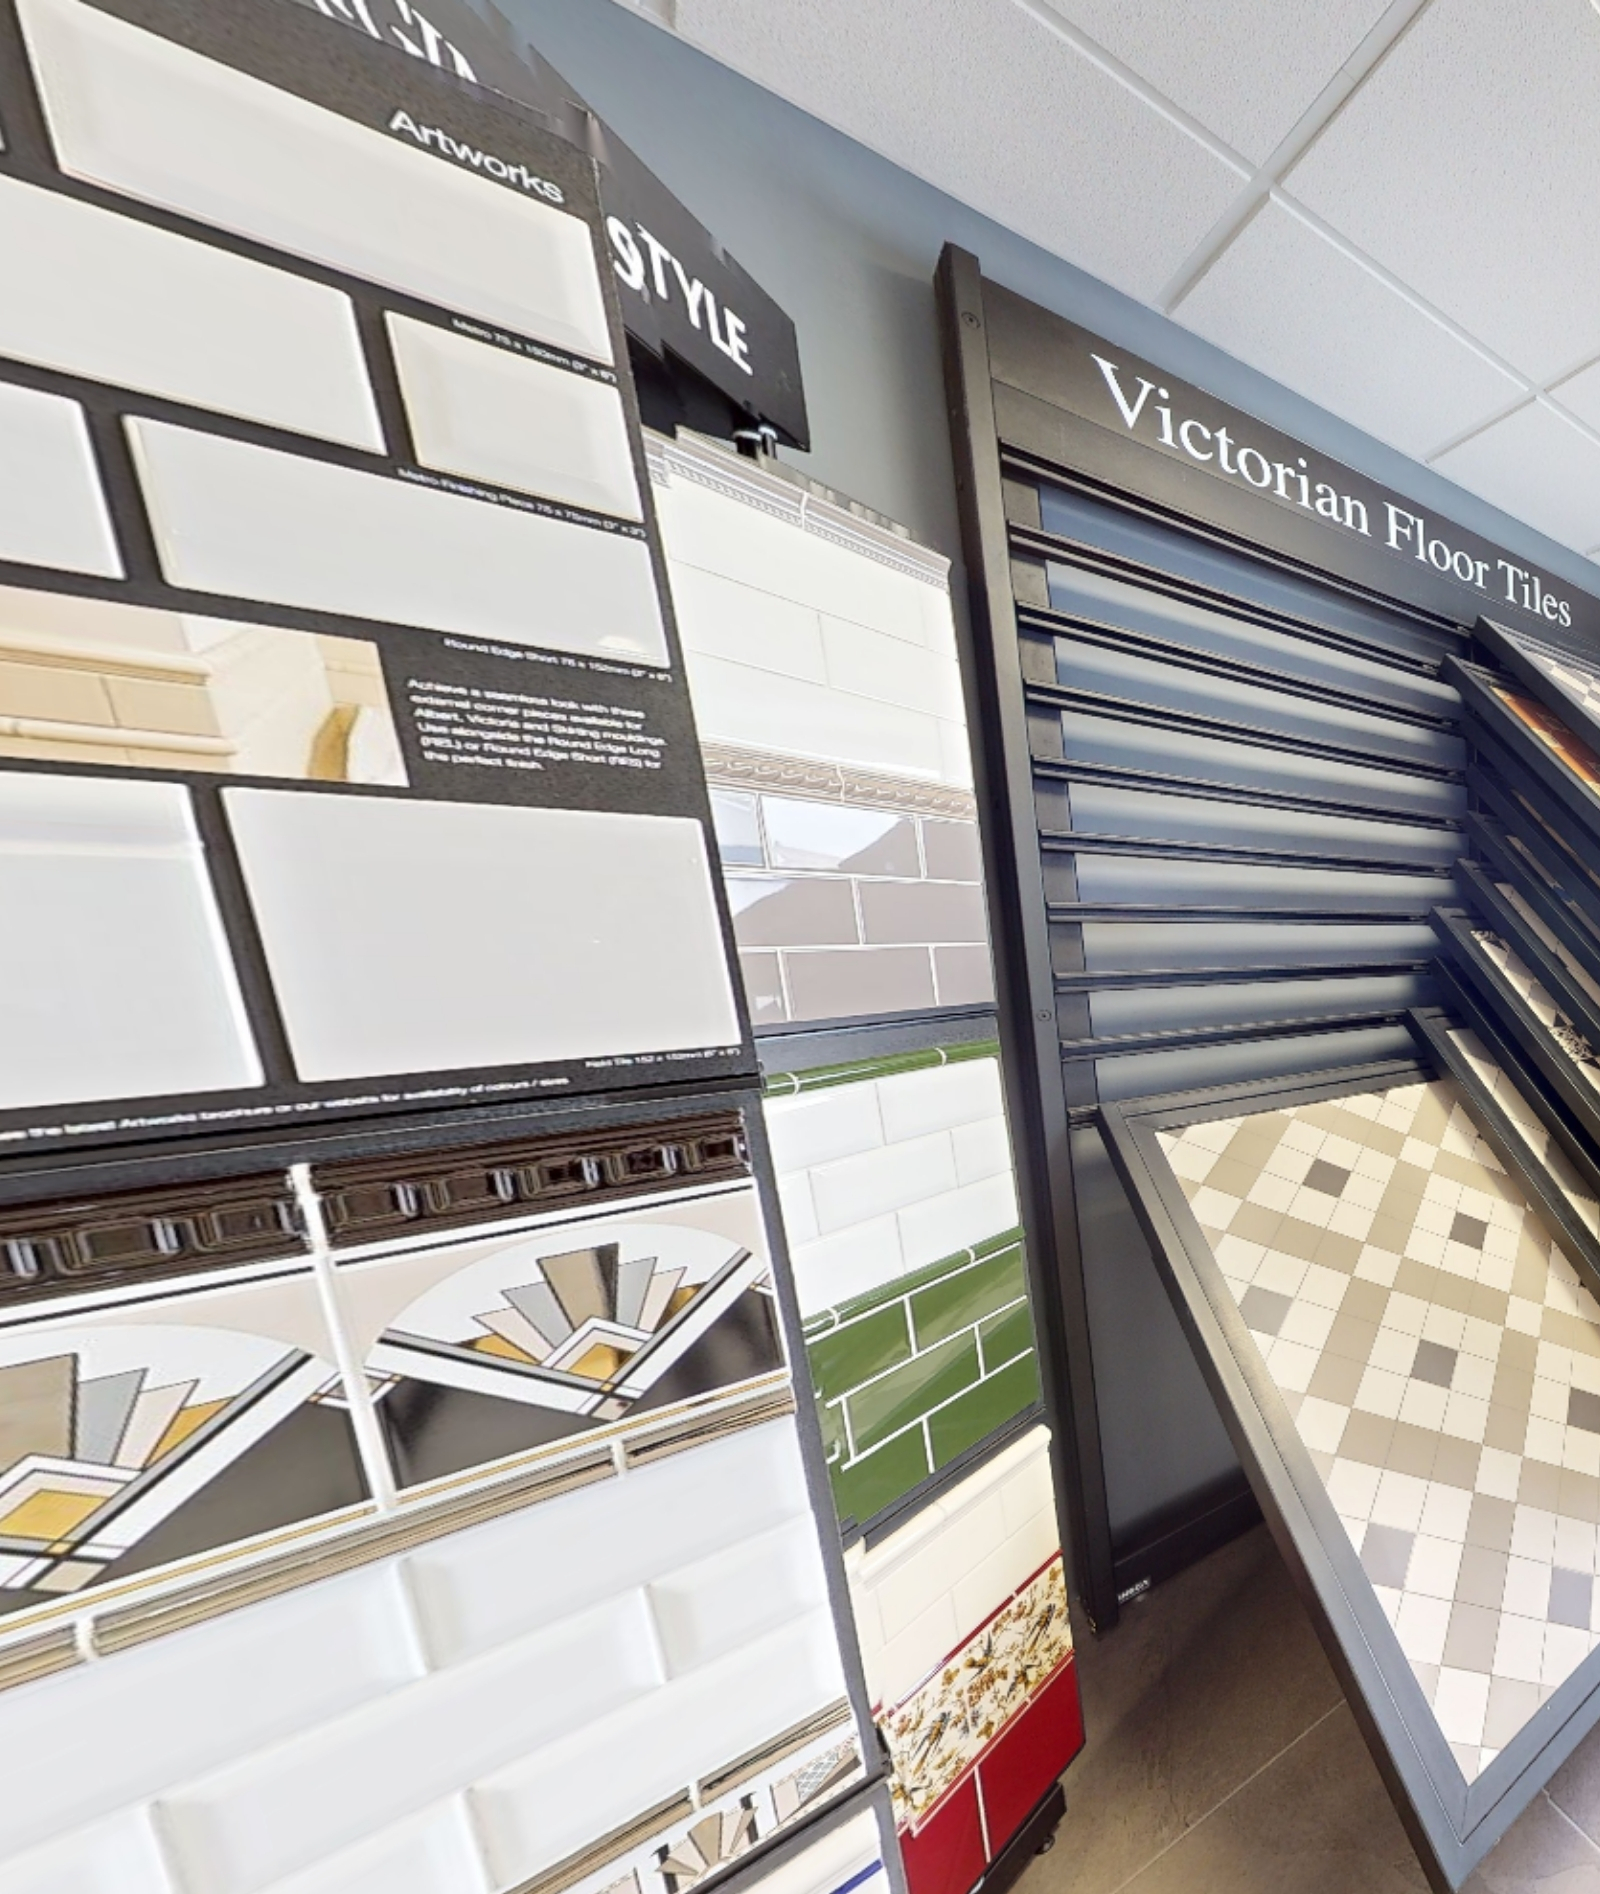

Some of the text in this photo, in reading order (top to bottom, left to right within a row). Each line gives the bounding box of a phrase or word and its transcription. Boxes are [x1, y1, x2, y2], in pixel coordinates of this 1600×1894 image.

[390, 110, 564, 203] Artworks
[607, 215, 754, 376] STYLE
[1091, 353, 1572, 627] Victorian Floor Tiles
[482, 742, 531, 757] Round
[547, 735, 592, 751] Round
[118, 1112, 197, 1129] Artworks
[199, 1104, 273, 1121] brochure
